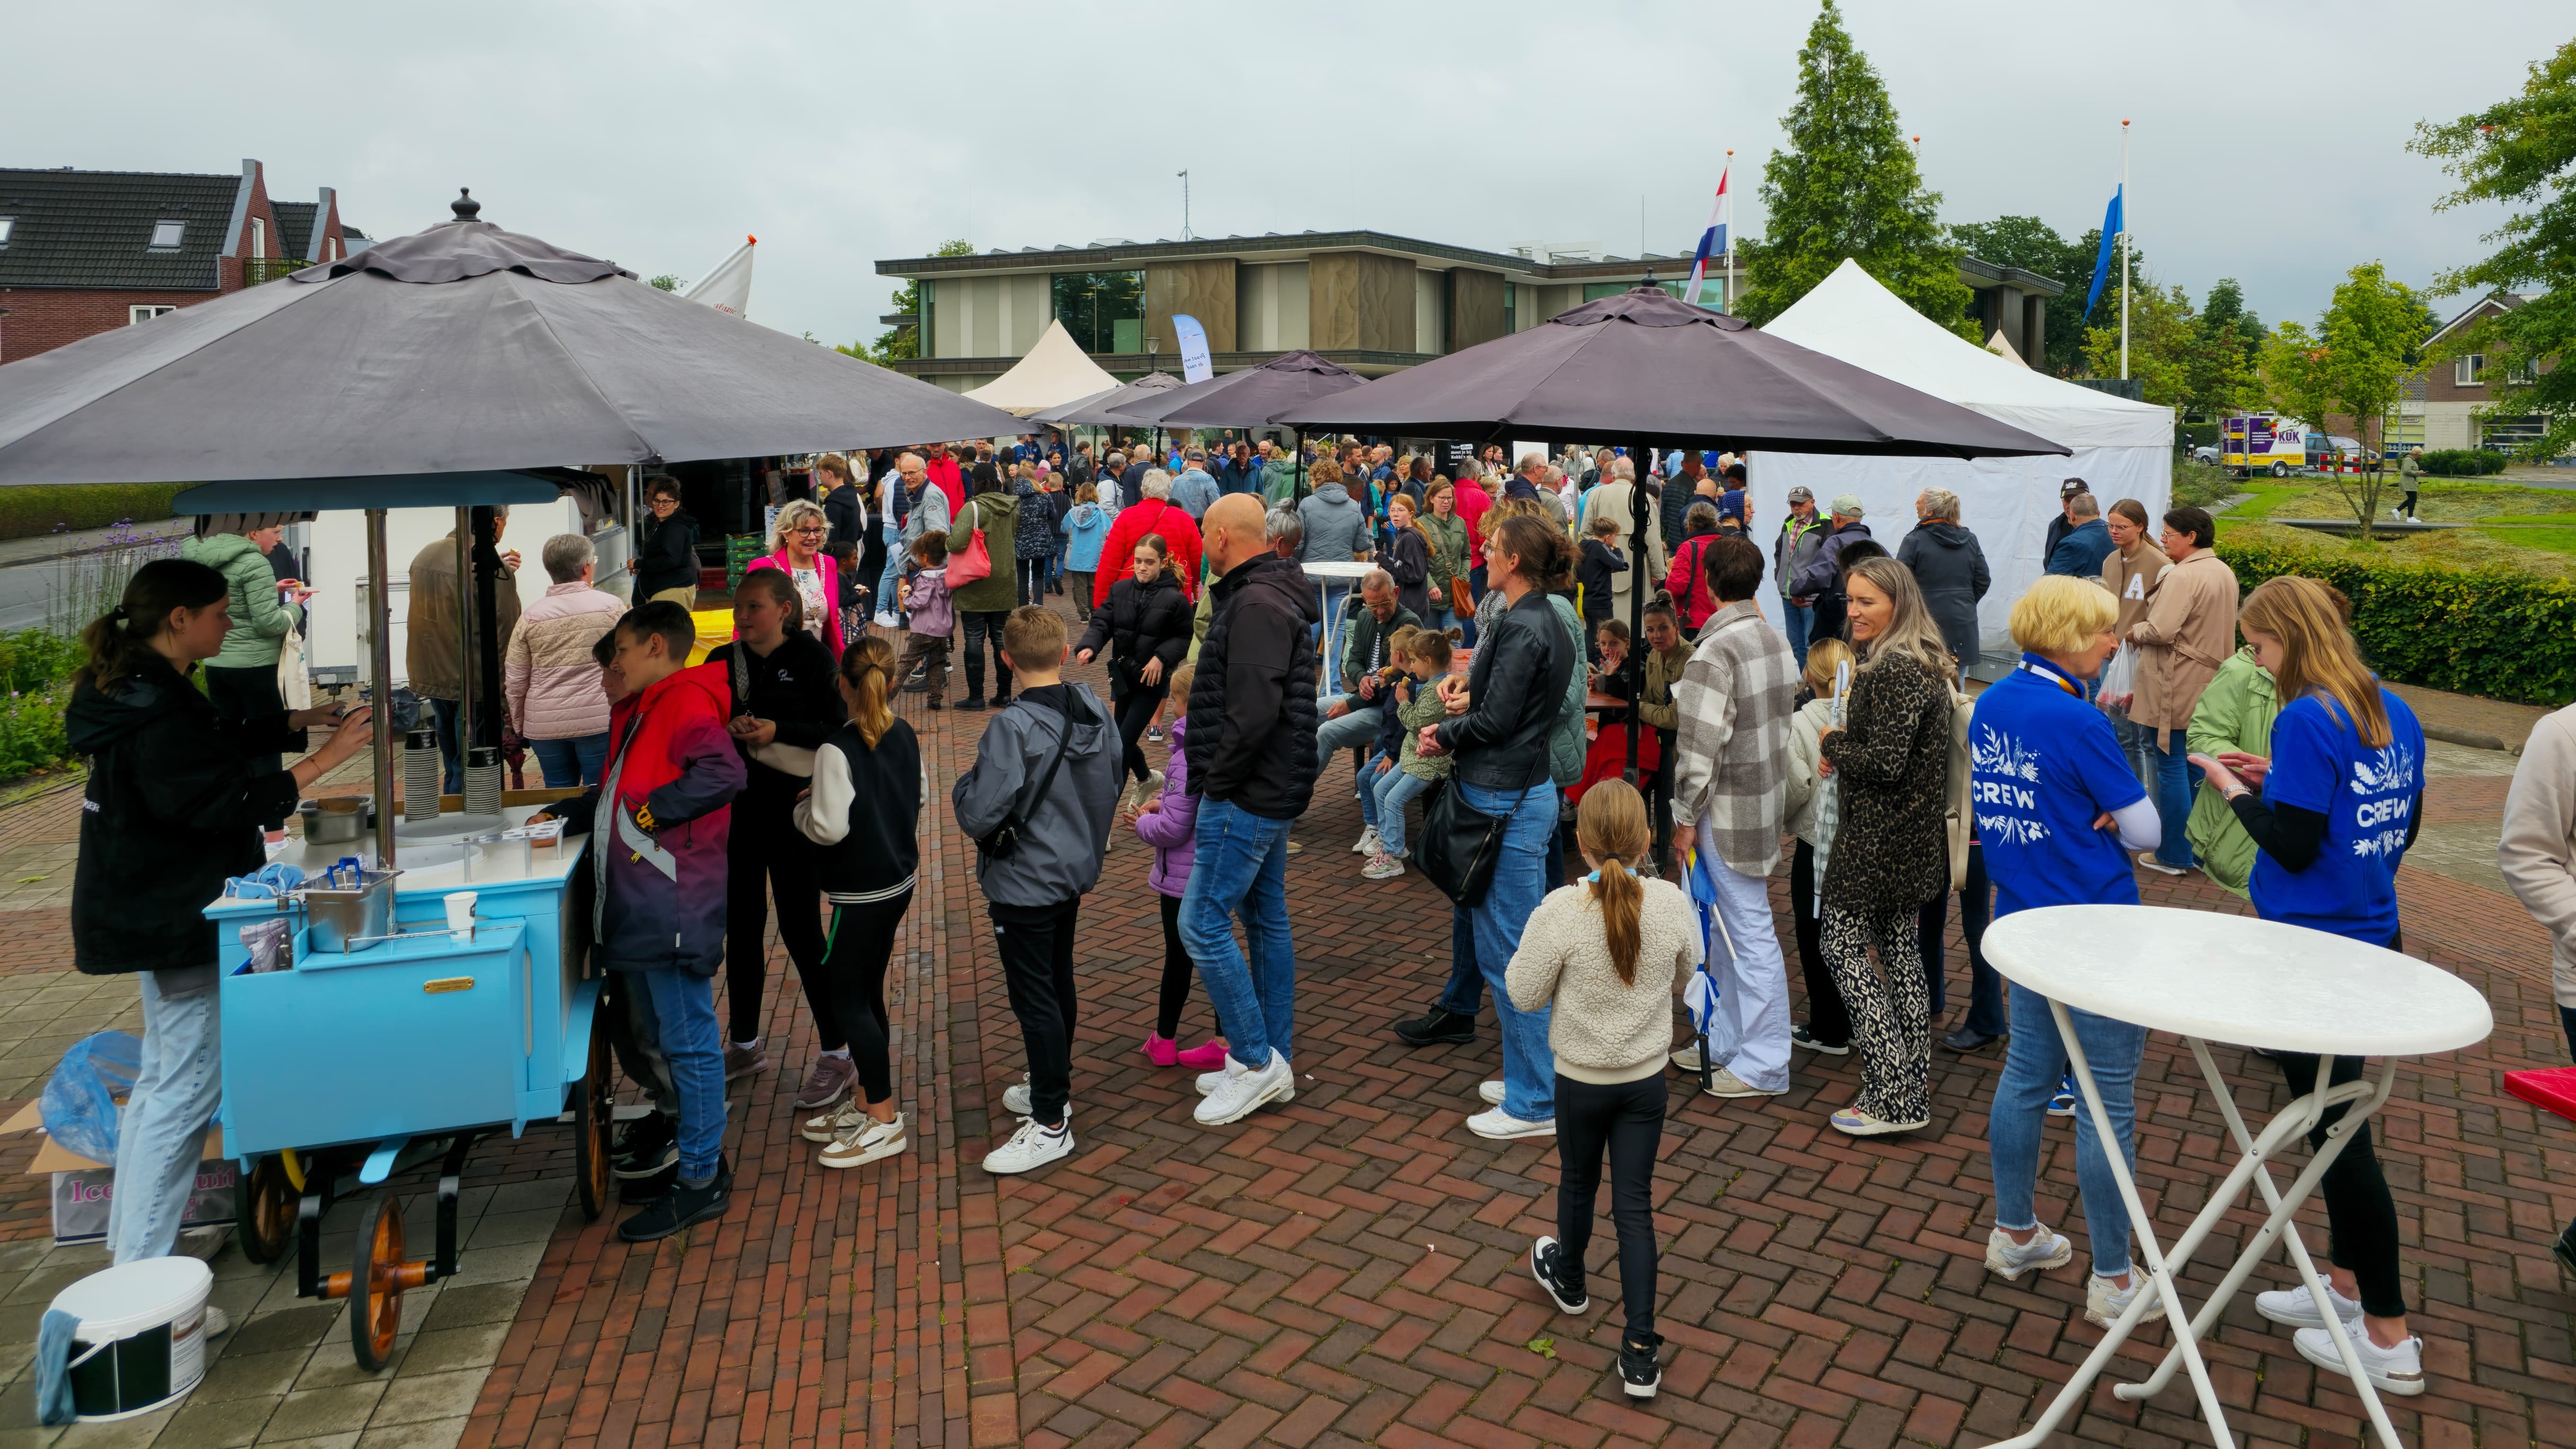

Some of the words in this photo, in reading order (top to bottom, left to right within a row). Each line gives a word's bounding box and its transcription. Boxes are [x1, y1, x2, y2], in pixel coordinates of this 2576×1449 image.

[2278, 432, 2301, 444] KOK
[2124, 573, 2144, 600] A
[1972, 780, 2034, 810] CREW
[2357, 794, 2411, 827] CREW
